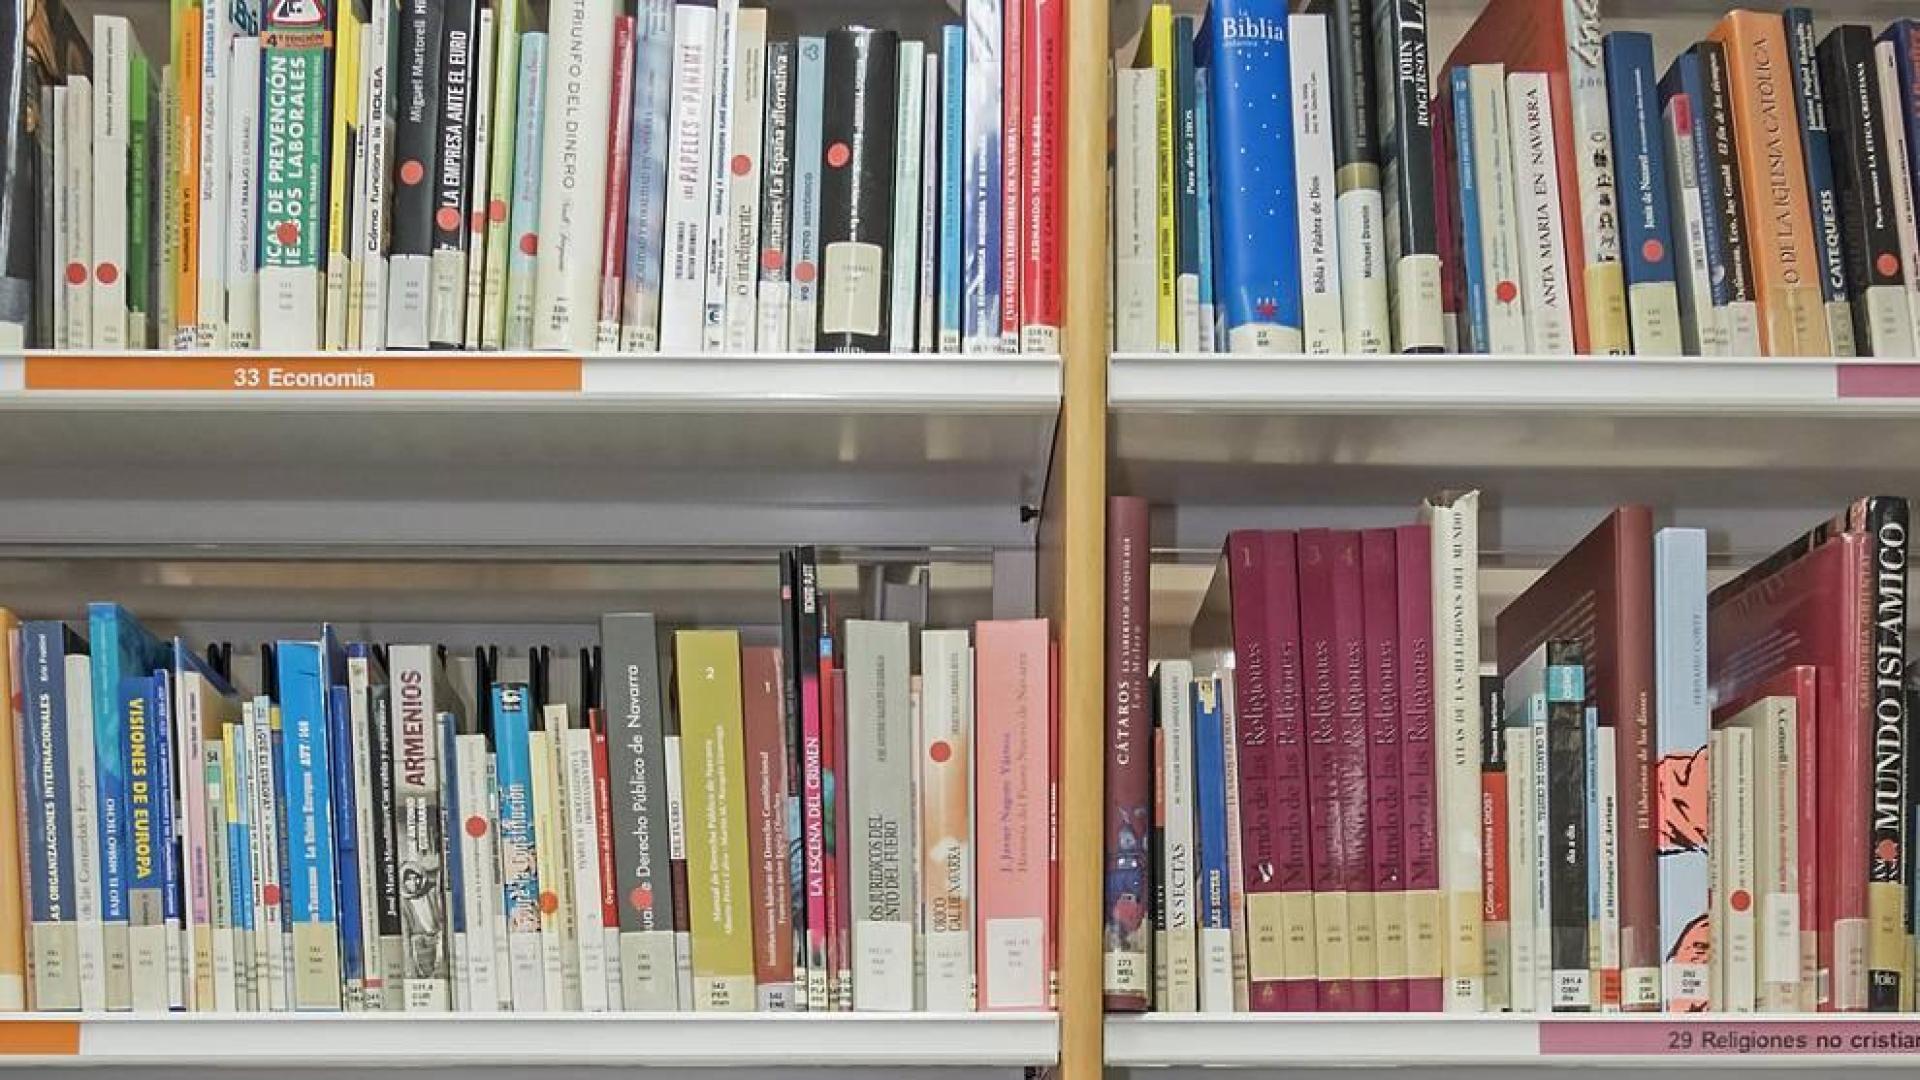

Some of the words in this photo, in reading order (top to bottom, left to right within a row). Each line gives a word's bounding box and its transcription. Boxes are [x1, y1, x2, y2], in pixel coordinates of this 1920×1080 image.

[448, 31, 466, 64] EURO
[566, 0, 586, 77] TRIUNFO
[1223, 18, 1284, 41] Biblia
[411, 20, 427, 76] Martorell
[1400, 40, 1414, 82] JOHN
[447, 68, 465, 83] EL
[681, 43, 703, 103] PANAMÁ
[772, 56, 788, 126] alternativa
[1411, 40, 1428, 126] ROGERSON
[371, 66, 384, 120] BOLSA
[410, 80, 426, 122] Miguel
[446, 86, 464, 121] ANTE
[565, 83, 582, 117] DEL
[267, 57, 286, 182] PREVENCIÓN
[288, 57, 305, 177] LABORALES
[371, 126, 382, 138] la
[1184, 110, 1194, 138] DIOS
[1525, 88, 1546, 164] NAVARRA
[445, 126, 462, 185] EMPRESA
[562, 122, 581, 190] DINERO
[680, 121, 700, 182] PAPELES
[770, 130, 786, 175] España
[1045, 140, 1054, 168] CASA
[1185, 142, 1195, 168] decir
[1868, 154, 1877, 168] LA
[369, 143, 382, 203] funciona
[1186, 170, 1196, 194] Para
[1310, 176, 1322, 199] Dios
[1532, 173, 1549, 194] EN
[1722, 164, 1735, 196] Gould
[1764, 137, 1789, 206] IGLESIA
[268, 190, 284, 212] DE
[444, 190, 460, 206] LA
[1311, 202, 1322, 214] de
[368, 210, 381, 251] Cómo
[1032, 197, 1040, 260] FERNANDO
[1312, 218, 1324, 254] Palabra
[1360, 205, 1371, 239] Drosnin
[1774, 210, 1793, 235] LA
[1821, 190, 1843, 287] CATEQUESIS
[737, 205, 755, 282] inteligente
[1045, 241, 1054, 263] QUE
[1361, 242, 1372, 278] Michael
[1045, 270, 1054, 316] HOMBRE
[1313, 266, 1326, 293] Biblia
[234, 369, 260, 386] 33
[1453, 512, 1463, 559] MUNDO
[1454, 566, 1463, 590] DEL
[1876, 522, 1906, 688] ISLÁMICO
[1454, 594, 1464, 672] RELIGIONES
[705, 667, 714, 680] 2
[1310, 639, 1336, 744] Religiones
[1341, 638, 1365, 745] Religiones
[1406, 638, 1429, 742] Religiones
[1455, 678, 1465, 700] LAS
[626, 664, 644, 728] Navarra
[1241, 640, 1267, 745] Religiones
[1373, 640, 1397, 744] Religiones
[1636, 692, 1648, 726] dioses
[400, 670, 426, 786] ARMENIOS
[1115, 680, 1130, 766] CÁTAROS
[1455, 708, 1465, 723] DE
[39, 694, 56, 798] INTERNACIONALES
[128, 698, 148, 776] VISIONES
[631, 734, 645, 754] de
[1455, 728, 1466, 766] ATLAS
[1637, 729, 1648, 746] los
[1638, 748, 1648, 761] de
[806, 736, 820, 788] CRIMEN
[1874, 698, 1903, 832] MUNDO
[131, 782, 149, 804] DE
[632, 758, 648, 812] Público
[706, 780, 715, 791] de
[760, 752, 772, 816] Constitucional
[1016, 765, 1027, 799] Fuero
[1638, 764, 1649, 814] laberinto
[106, 798, 117, 834] TECHO
[707, 794, 717, 828] Público
[808, 792, 821, 818] DEL
[1640, 817, 1650, 828] El
[131, 808, 151, 878] EUROPA
[504, 784, 527, 868] Constitución
[762, 820, 773, 858] Derecho
[868, 815, 883, 838] DEL
[884, 822, 899, 862] FUERO
[44, 802, 60, 900] ORGANIZACIONES
[107, 837, 119, 874] MISMO
[636, 816, 651, 877] Derecho
[671, 836, 681, 857] DEL
[708, 831, 719, 872] Derecho
[809, 822, 822, 873] ESCENA
[385, 864, 396, 892] María
[710, 874, 720, 884] de
[764, 861, 773, 872] de
[885, 866, 899, 888] DEL
[947, 846, 961, 892] NAVARRA
[1170, 842, 1186, 908] SECTAS
[1485, 870, 1495, 882] se
[109, 890, 120, 916] BAJO
[711, 888, 722, 922] Manual
[764, 874, 775, 906] básicas
[776, 886, 787, 924] Francisco
[811, 878, 822, 896] LA
[1209, 870, 1220, 906] SECTAS
[386, 896, 397, 916] José
[1211, 910, 1221, 928] LAS
[765, 908, 777, 966] Instituciones
[1668, 1032, 1692, 1048] 29
[1702, 1030, 1807, 1053] Religiones
[1816, 1036, 1842, 1048] no
